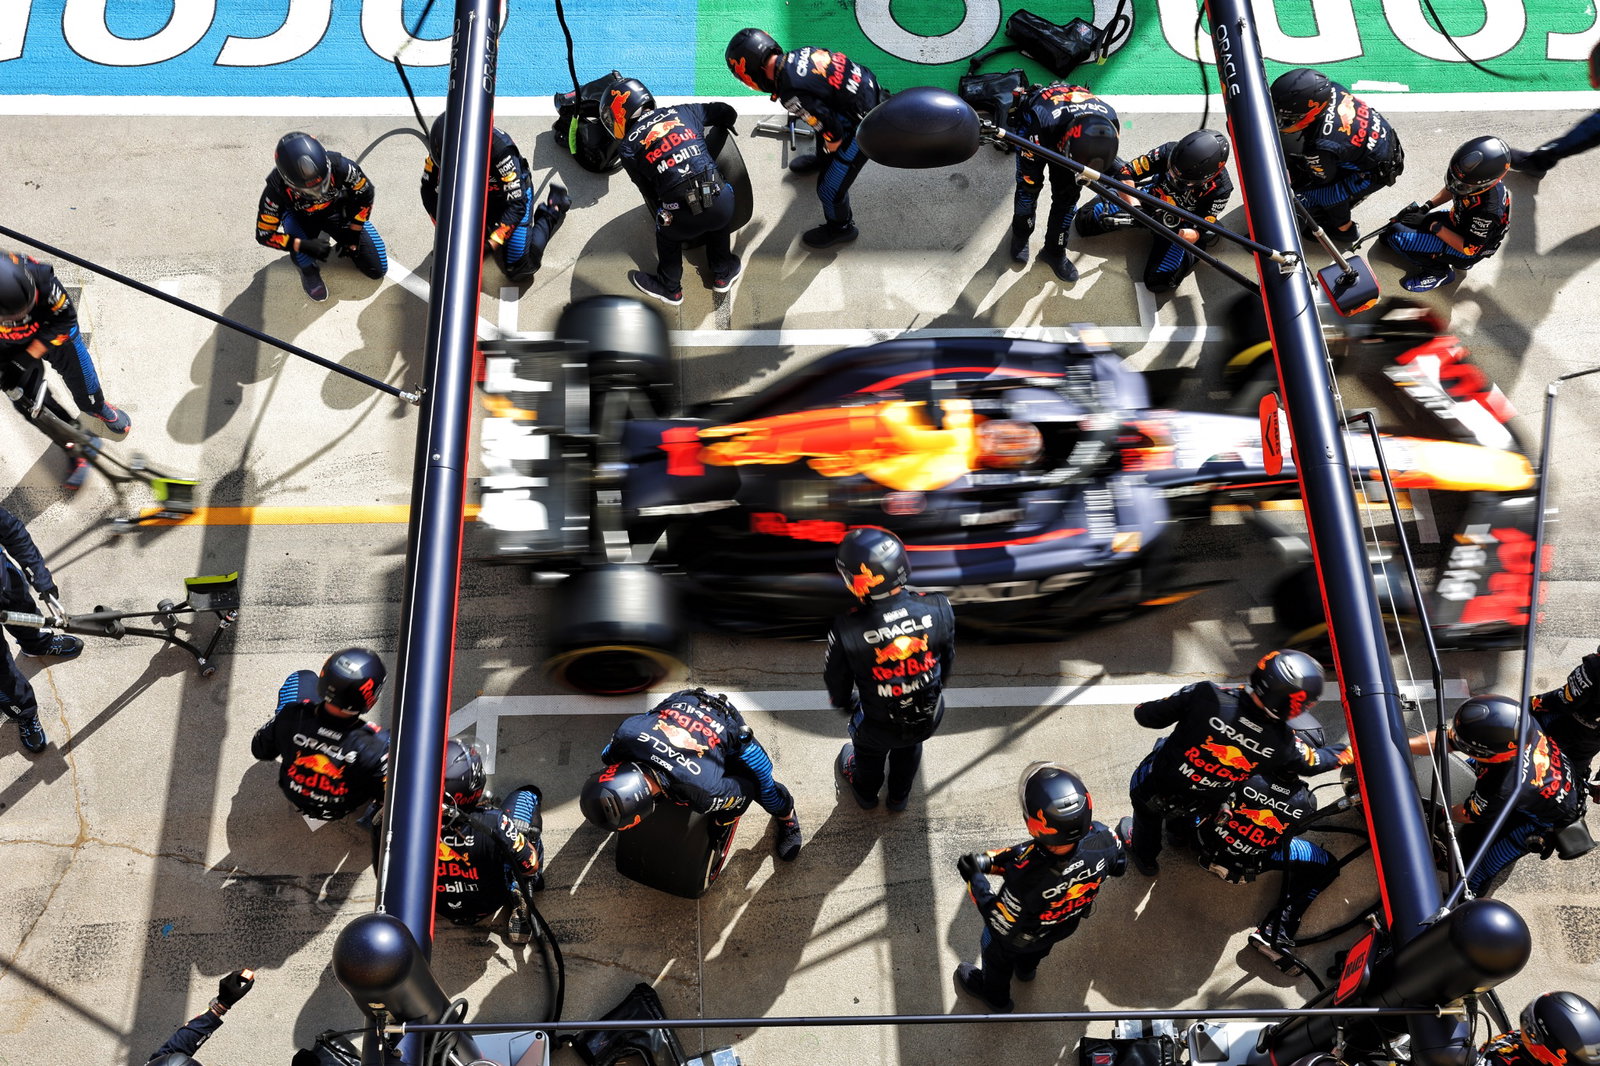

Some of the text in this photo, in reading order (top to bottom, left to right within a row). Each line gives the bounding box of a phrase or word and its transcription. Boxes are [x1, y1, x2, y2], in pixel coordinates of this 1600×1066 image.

[482, 17, 498, 94] ORACLE
[1216, 24, 1241, 99] ORACLE
[628, 108, 678, 142] ORACLE
[1350, 117, 1369, 147] Red
[645, 138, 673, 164] Red
[656, 150, 690, 174] Mobil
[863, 614, 933, 645] ORACLE
[687, 705, 725, 735] Mobil
[690, 719, 721, 750] Red
[293, 733, 358, 764] ORACLE
[1208, 716, 1275, 758] ORACLE
[637, 731, 702, 776] ORACLE
[1184, 747, 1217, 773] Red
[288, 764, 320, 787] Red
[1539, 772, 1562, 799] Red
[1243, 786, 1304, 819] ORACLE
[1214, 826, 1252, 854] Mobil
[1228, 820, 1254, 837] ed
[449, 863, 479, 880] Bull
[1042, 858, 1105, 899] ORACLE
